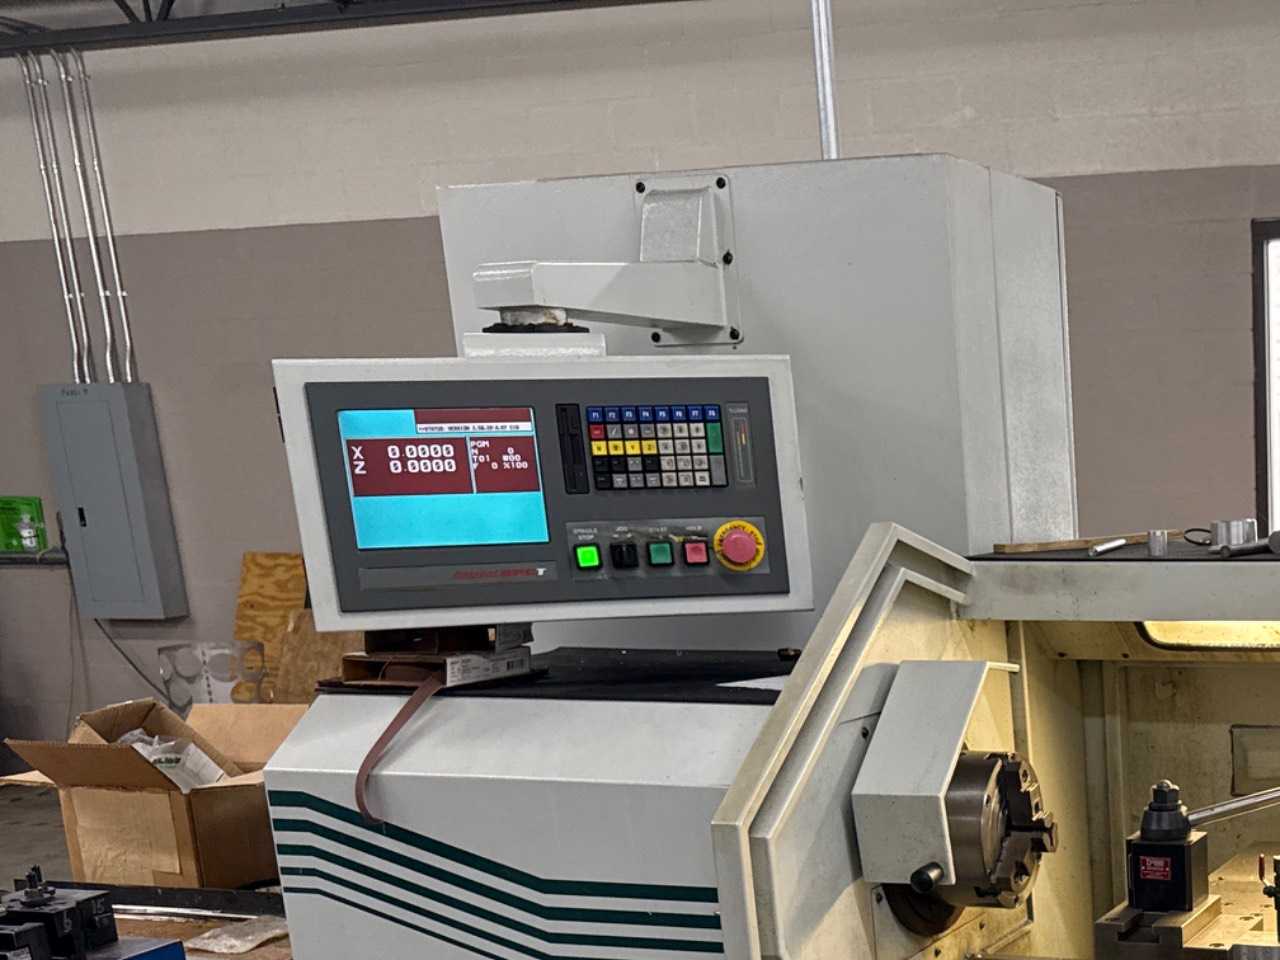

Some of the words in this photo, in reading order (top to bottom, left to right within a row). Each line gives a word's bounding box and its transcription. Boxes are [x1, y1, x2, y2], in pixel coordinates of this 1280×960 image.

[470, 440, 490, 448] PGM
[352, 446, 364, 460] X
[388, 444, 454, 458] 0.0000
[354, 462, 366, 474] Z
[389, 459, 456, 474] 0.0000
